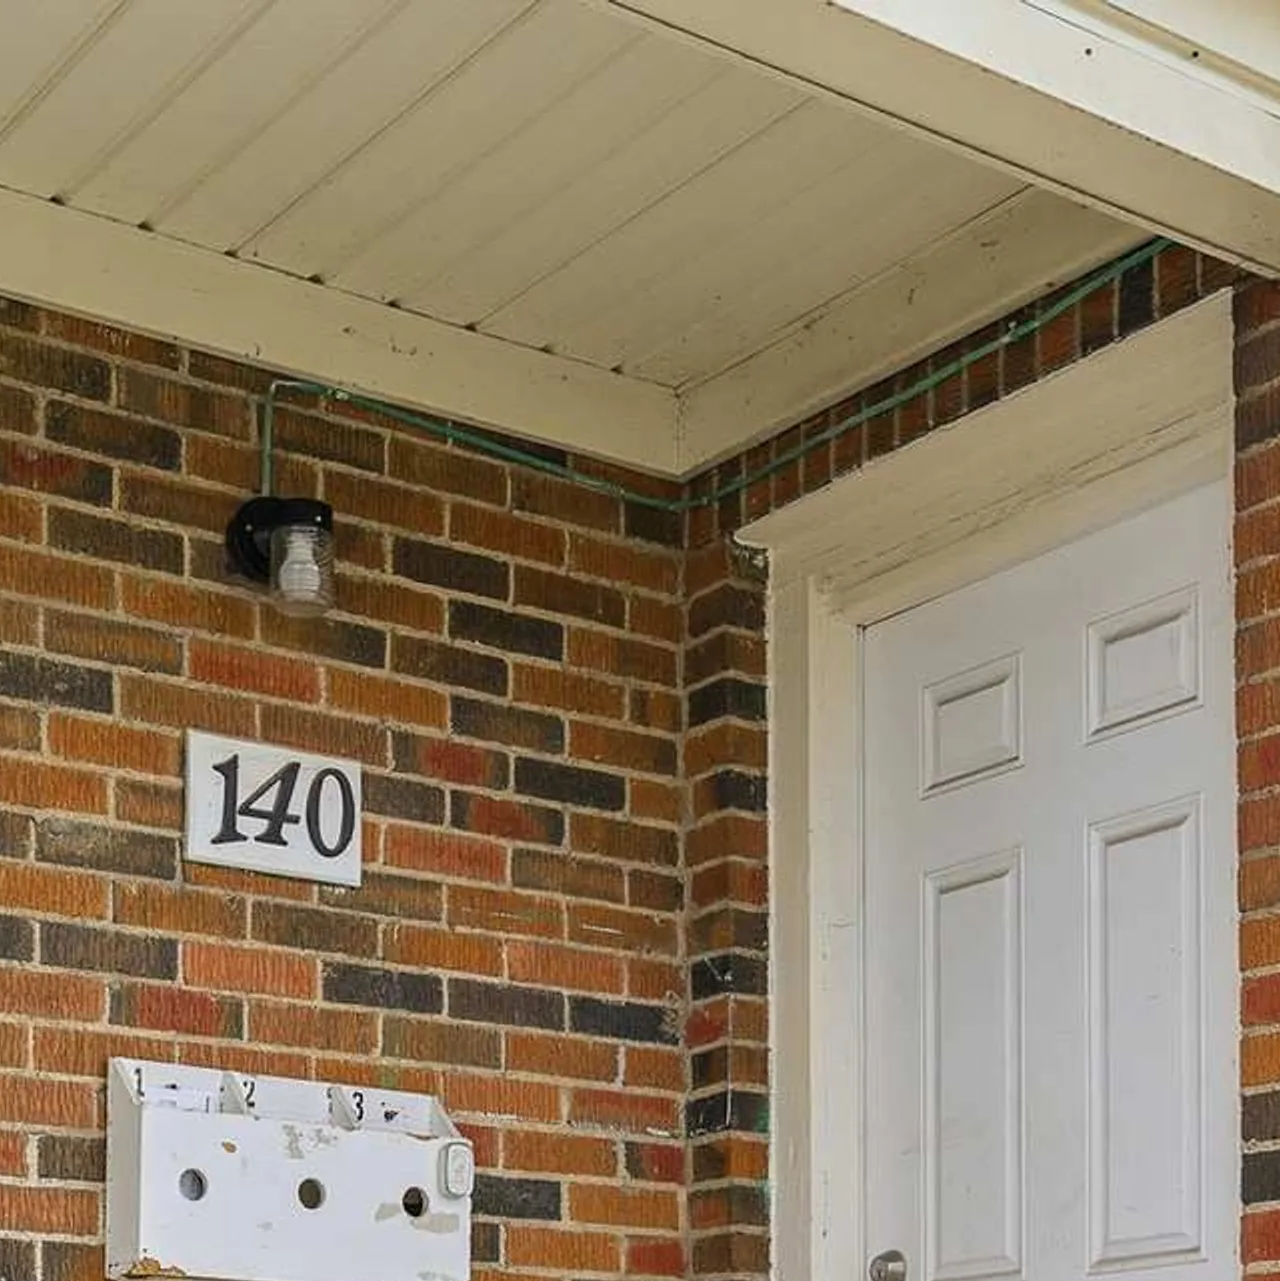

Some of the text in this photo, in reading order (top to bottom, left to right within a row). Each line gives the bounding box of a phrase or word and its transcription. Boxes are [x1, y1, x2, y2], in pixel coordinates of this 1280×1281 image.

[211, 754, 355, 858] 140
[135, 1068, 364, 1121] 1 2 3
